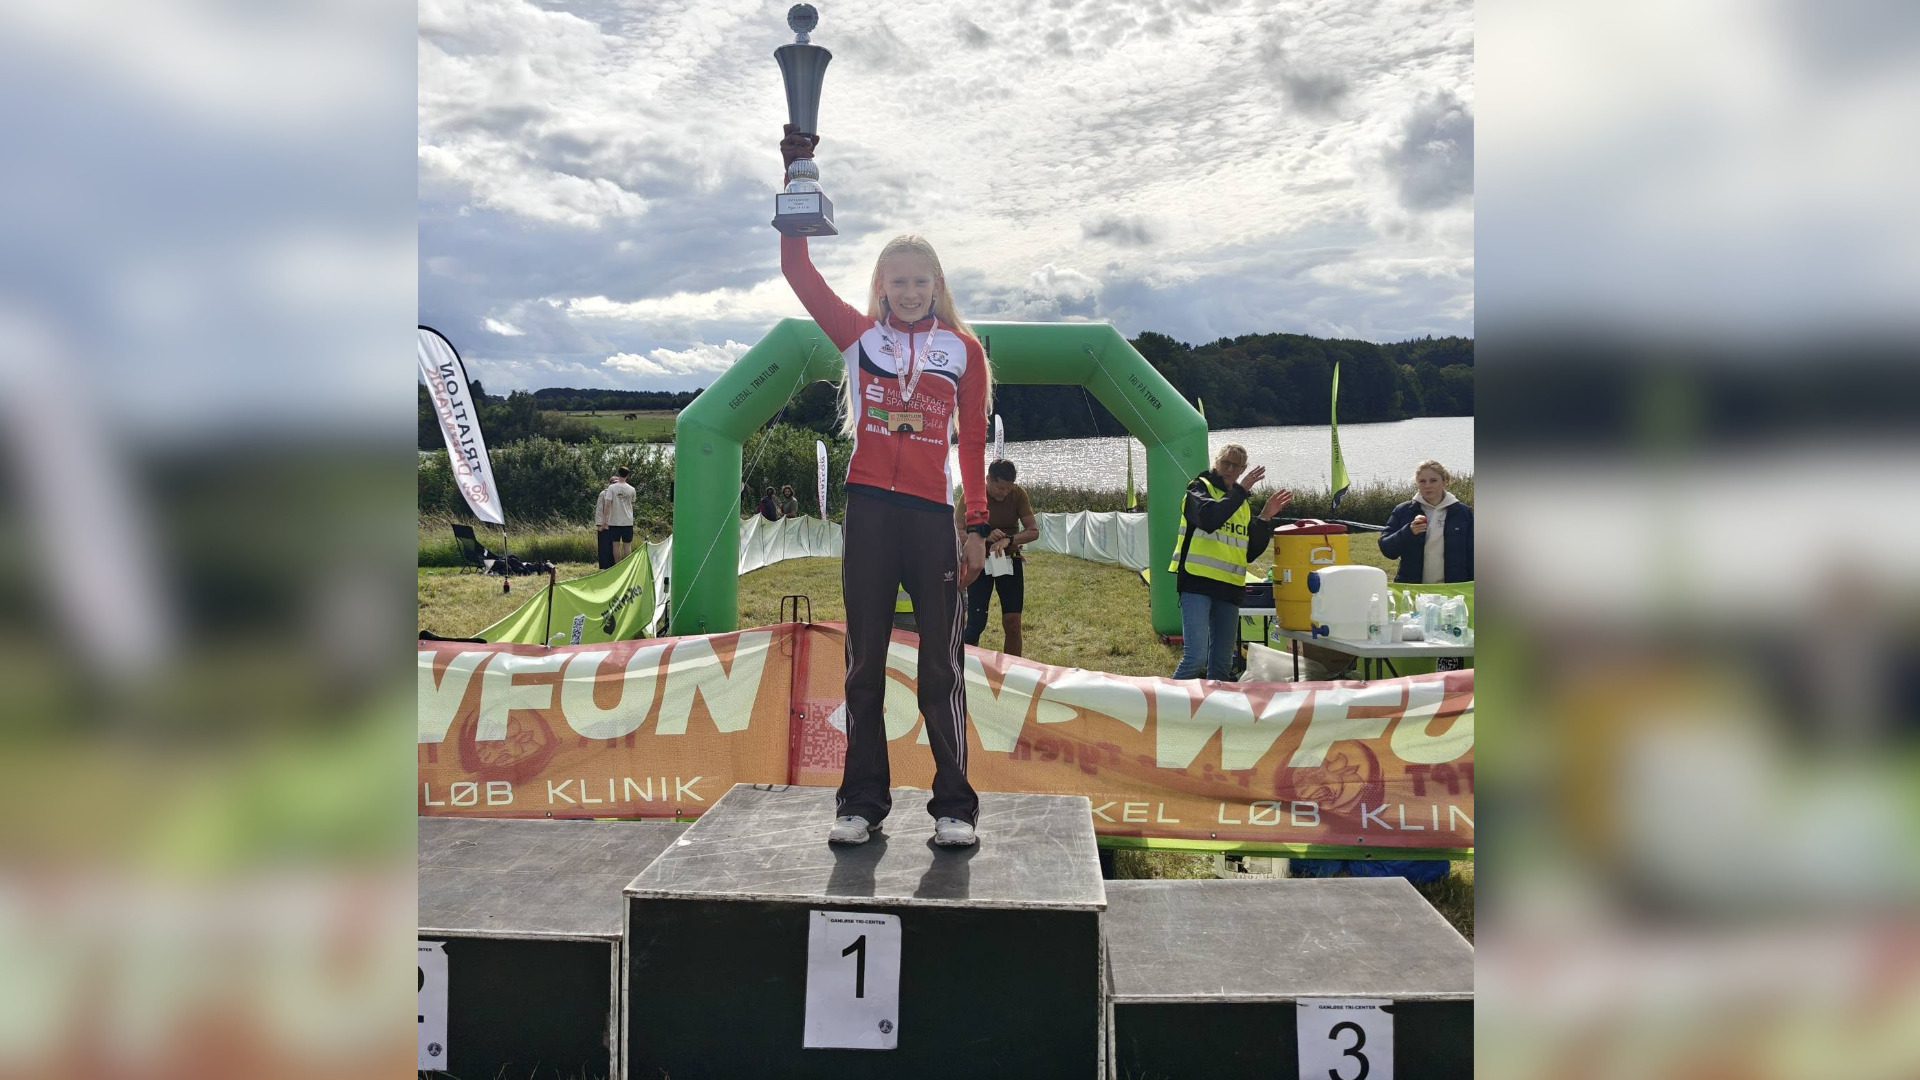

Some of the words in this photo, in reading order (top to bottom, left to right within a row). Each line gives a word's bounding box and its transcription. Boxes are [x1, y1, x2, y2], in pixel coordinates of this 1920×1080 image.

[729, 388, 753, 409] EGEDAL
[750, 362, 780, 390] TRIATLON
[1128, 374, 1138, 386] TRI
[1144, 391, 1163, 410] TYREN
[424, 780, 514, 806] LØB
[547, 776, 705, 804] KLINIK
[1218, 800, 1321, 827] LØB
[1361, 802, 1474, 831] KLIN
[842, 934, 866, 999] 1
[1328, 1021, 1370, 1080] 3
